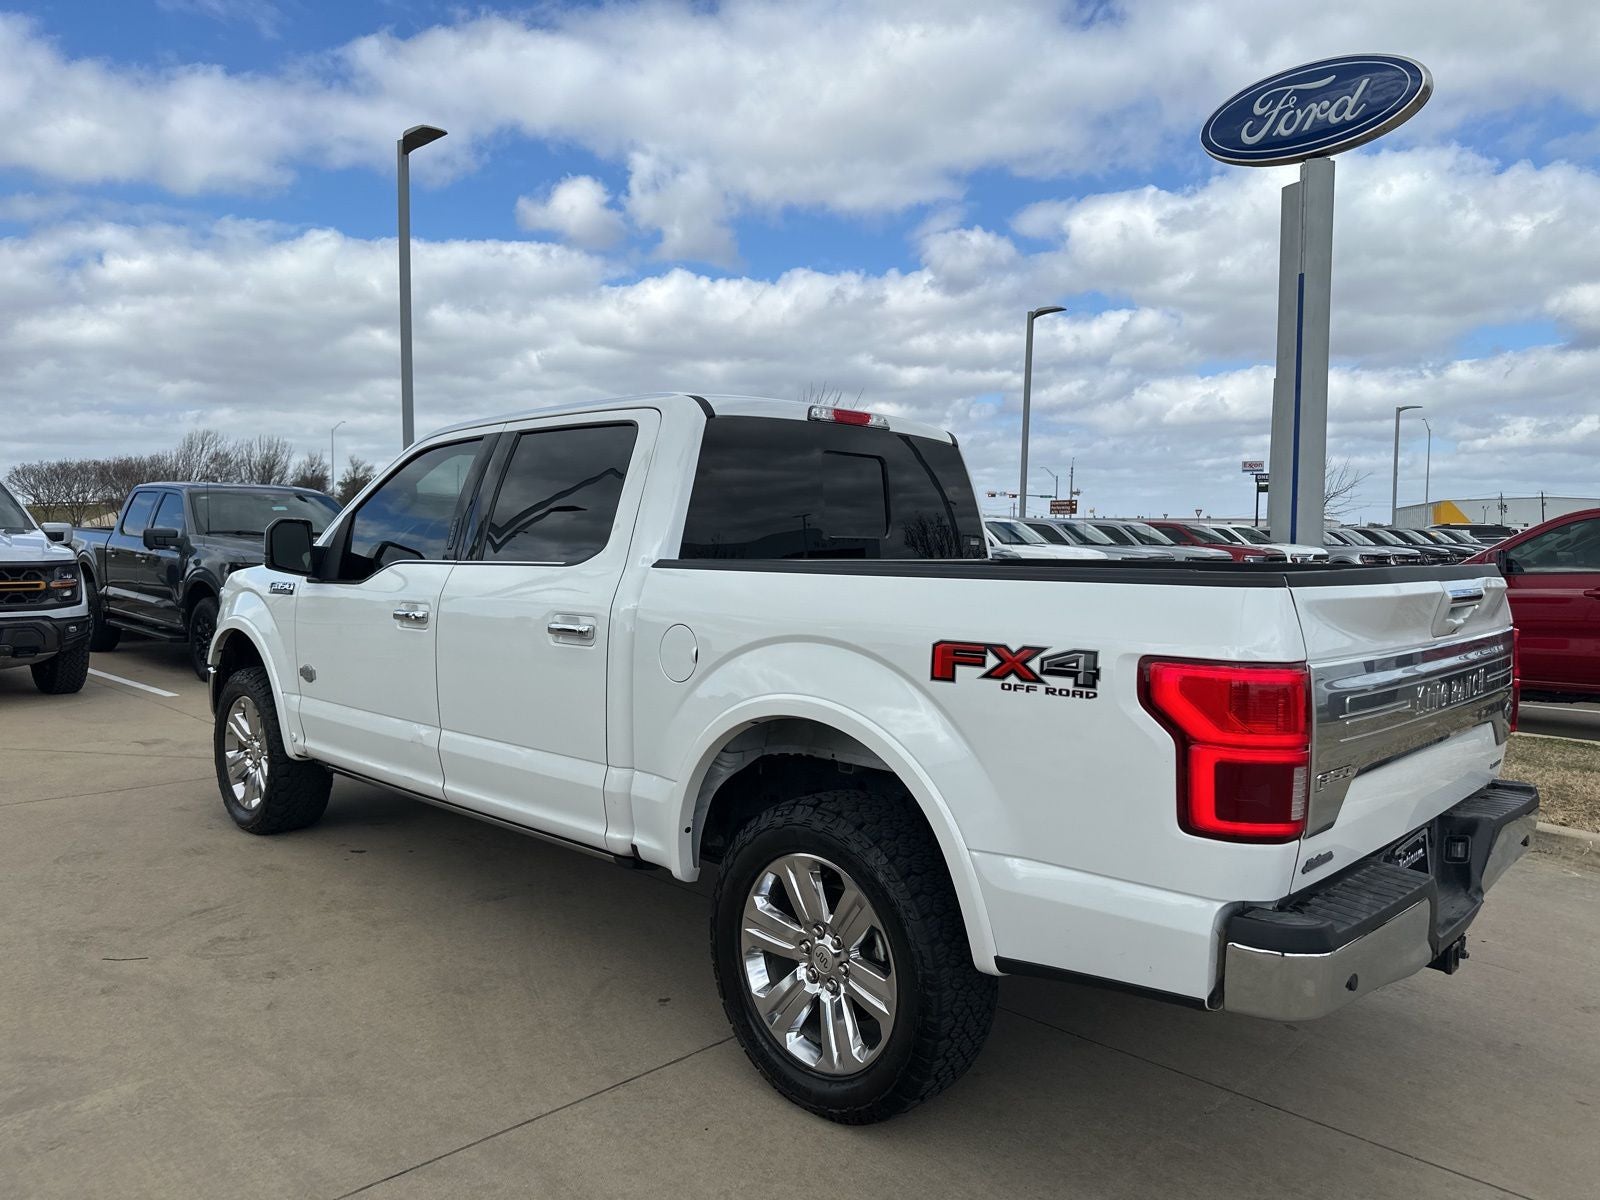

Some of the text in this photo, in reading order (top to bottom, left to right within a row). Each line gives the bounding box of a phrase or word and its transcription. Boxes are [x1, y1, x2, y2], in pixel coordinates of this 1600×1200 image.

[1240, 74, 1370, 145] Ford
[930, 640, 1102, 691] FX4
[1450, 668, 1485, 703] RANCH
[1000, 682, 1098, 700] OFF ROAD
